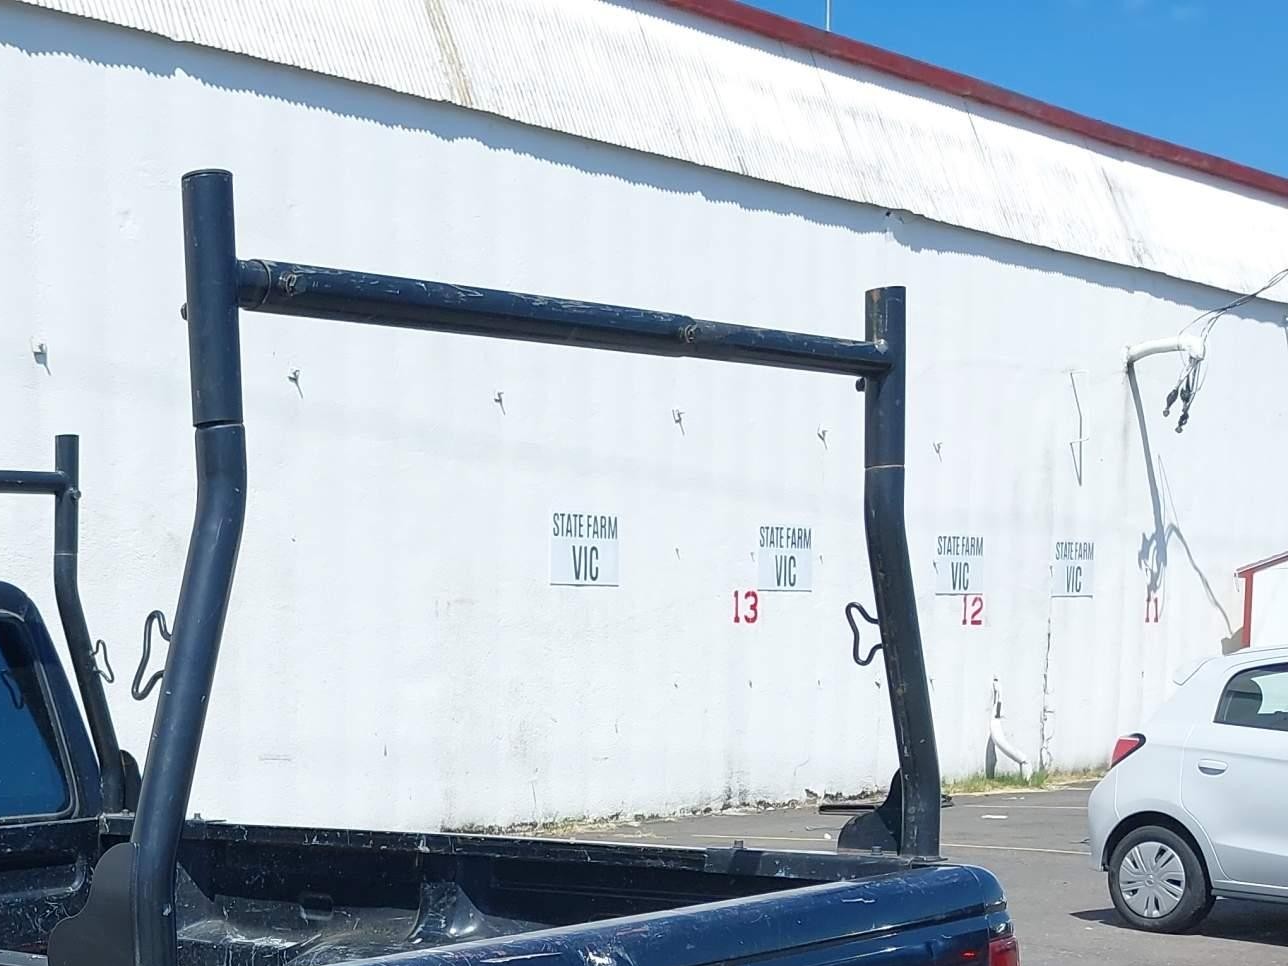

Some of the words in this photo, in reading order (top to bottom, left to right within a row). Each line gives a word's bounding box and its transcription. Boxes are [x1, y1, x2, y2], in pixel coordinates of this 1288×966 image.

[553, 512, 584, 538] STATE
[586, 515, 618, 540] FARM
[759, 526, 784, 549] STATE
[786, 527, 812, 550] FARM
[937, 535, 960, 556] STATE
[961, 536, 984, 557] FARM
[1055, 541, 1074, 561] STATE
[1075, 541, 1095, 561] FARM
[572, 545, 599, 582] VIC
[775, 554, 797, 587] VIC
[951, 562, 970, 591] VIC
[1066, 565, 1083, 593] VIC
[733, 589, 759, 624] 13
[962, 595, 984, 625] 12
